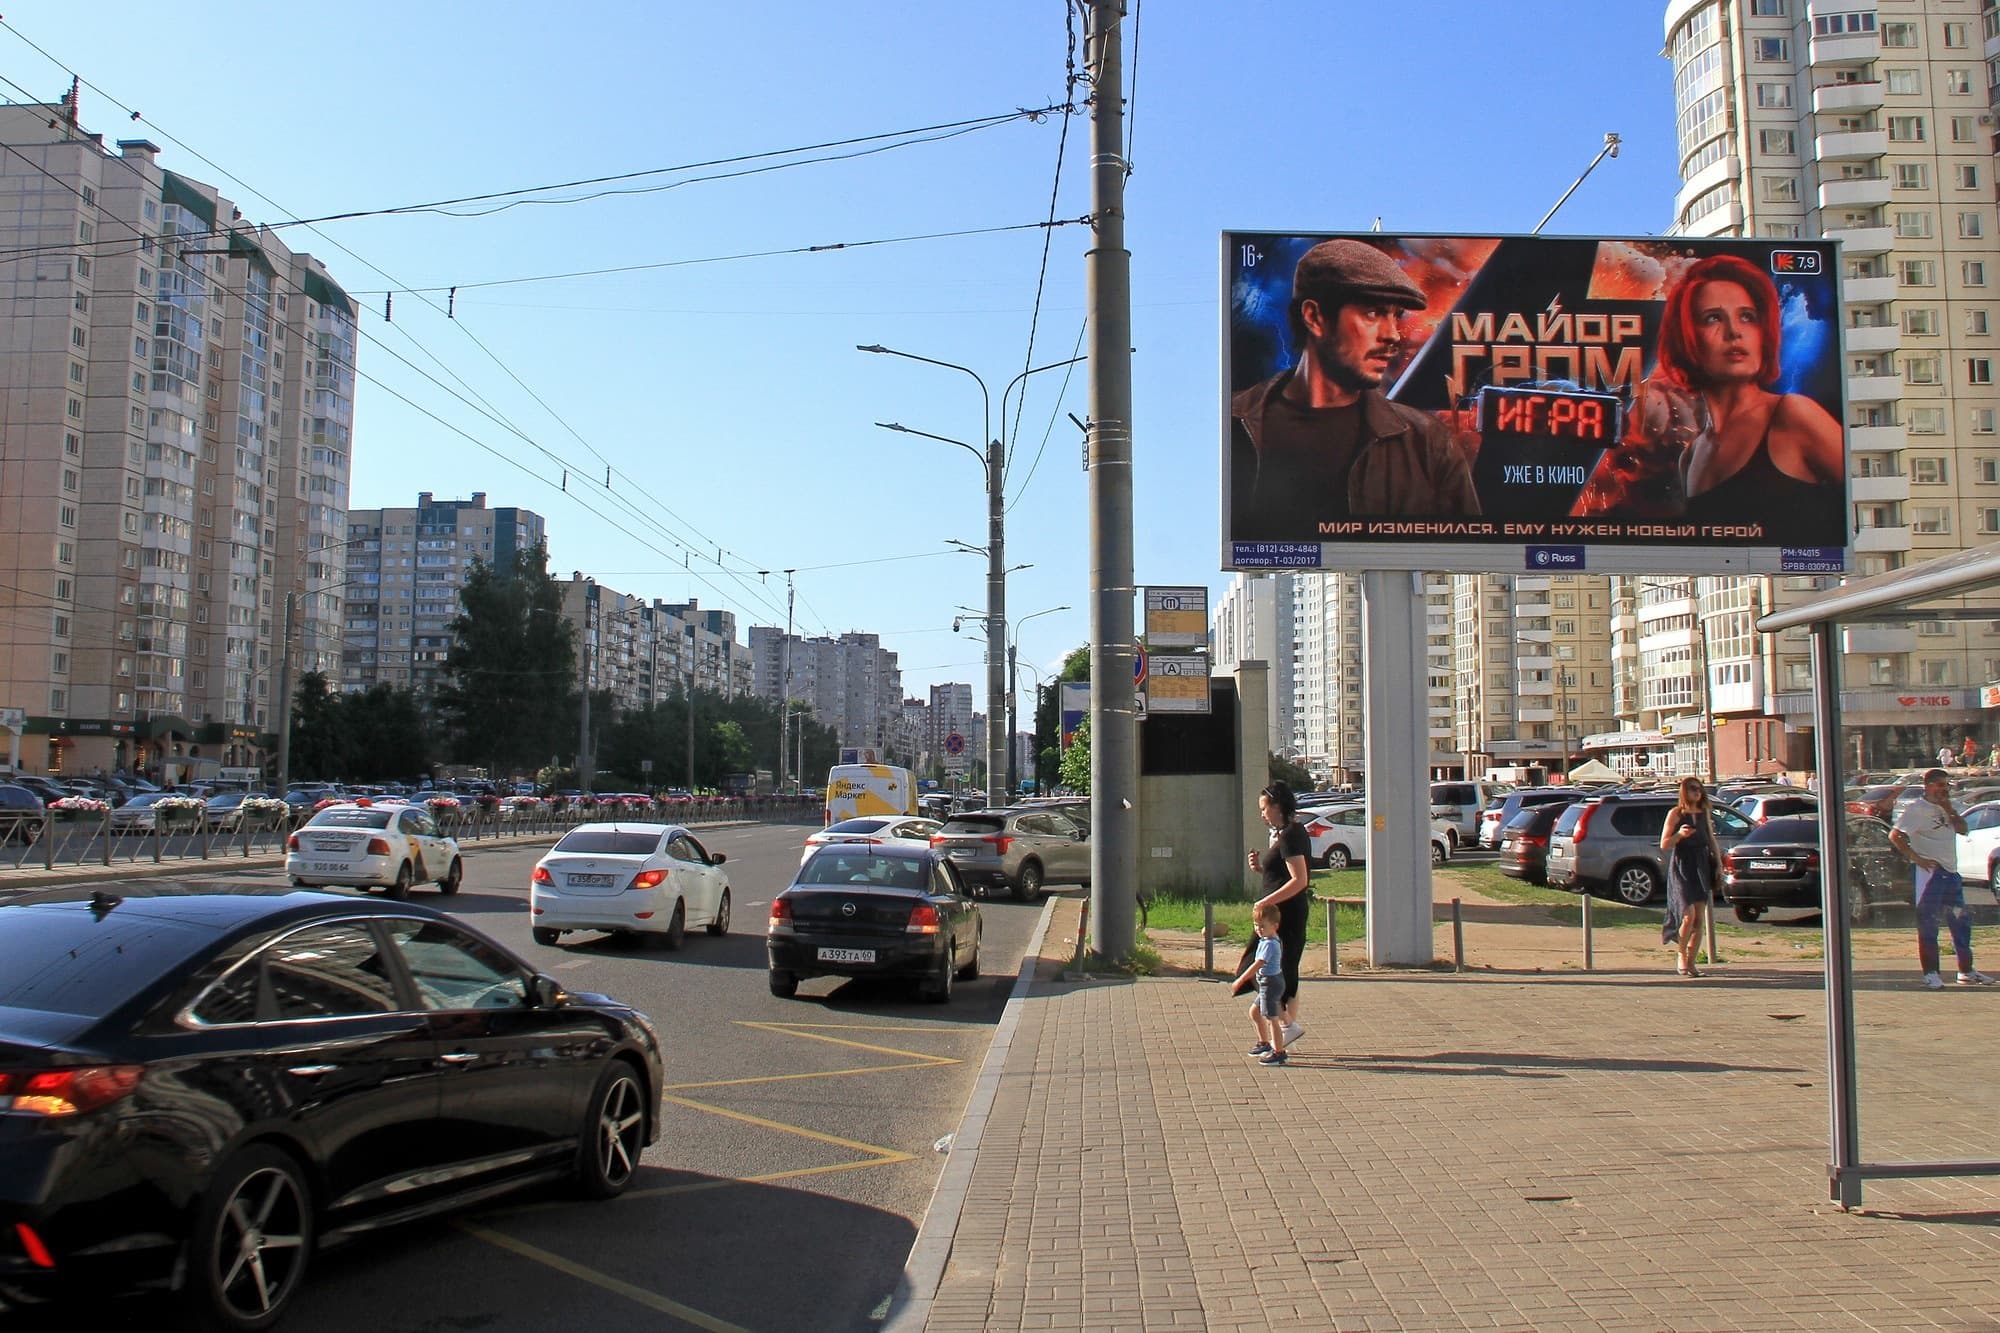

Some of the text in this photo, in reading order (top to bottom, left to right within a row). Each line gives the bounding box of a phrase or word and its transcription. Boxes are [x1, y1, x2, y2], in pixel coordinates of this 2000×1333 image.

[1241, 244, 1264, 267] 16+
[1796, 256, 1815, 270] 7,9
[1451, 297, 1643, 343] МАЙОР
[1447, 344, 1647, 399] ГРОМ
[1503, 464, 1585, 485] УЖЕ В КИНО
[1318, 522, 1763, 537] МИР ИЗМЕНИЛСЯ. ЕМУ НУЖЕН НОВЫЙ ГЕРОЙ
[1256, 544, 1278, 553] (812)
[1279, 545, 1318, 553] 438-4848
[1235, 557, 1273, 566] договор:
[1551, 552, 1576, 563] Russ
[1920, 696, 1951, 706] МКБ
[835, 780, 865, 791] Яндекс
[834, 790, 866, 801] Маркет
